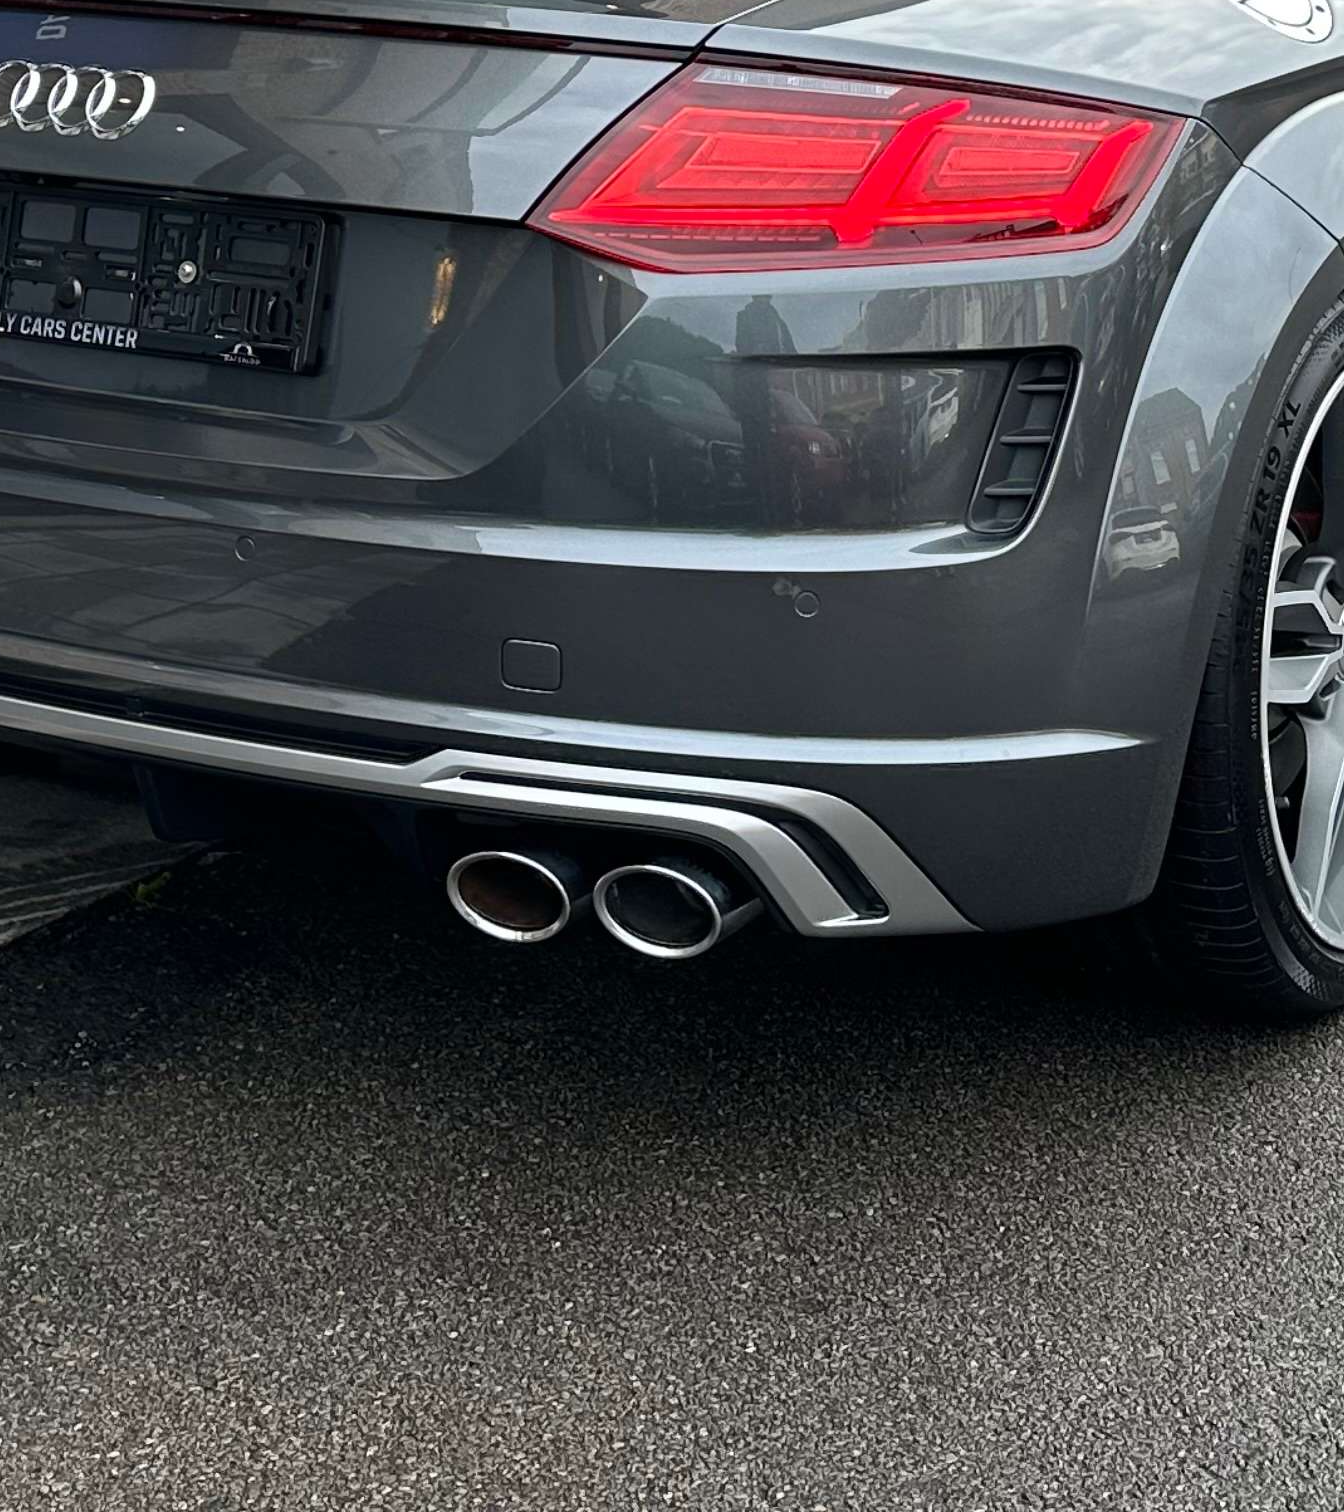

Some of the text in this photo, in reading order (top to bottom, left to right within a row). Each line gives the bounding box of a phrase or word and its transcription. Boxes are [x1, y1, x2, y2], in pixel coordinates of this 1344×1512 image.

[19, 315, 66, 339] CARS
[70, 322, 139, 349] CENTER
[1249, 488, 1271, 536] ZR
[1262, 446, 1282, 482] 19
[1277, 398, 1301, 437] XL
